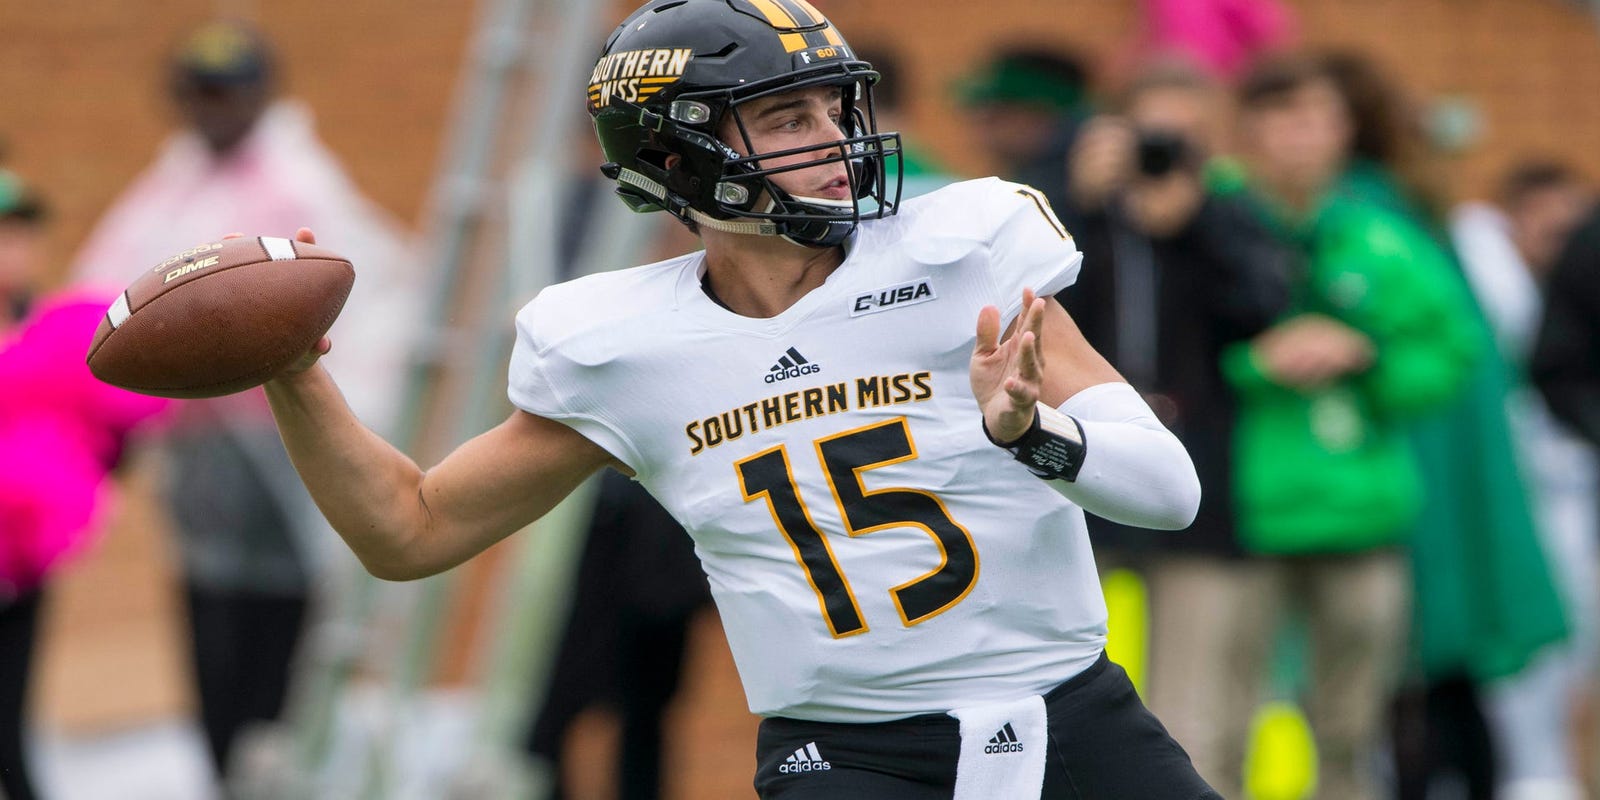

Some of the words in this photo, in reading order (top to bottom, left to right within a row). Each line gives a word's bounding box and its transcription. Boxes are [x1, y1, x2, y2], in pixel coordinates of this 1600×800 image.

[589, 48, 692, 85] OUTHERN
[600, 78, 640, 107] MISS
[163, 255, 219, 284] DIME
[764, 362, 820, 384] adidas
[686, 382, 848, 456] SOUTHERN
[855, 371, 932, 410] MISS
[733, 415, 980, 639] 15
[984, 741, 1023, 755] adidas
[779, 759, 831, 774] adidas
